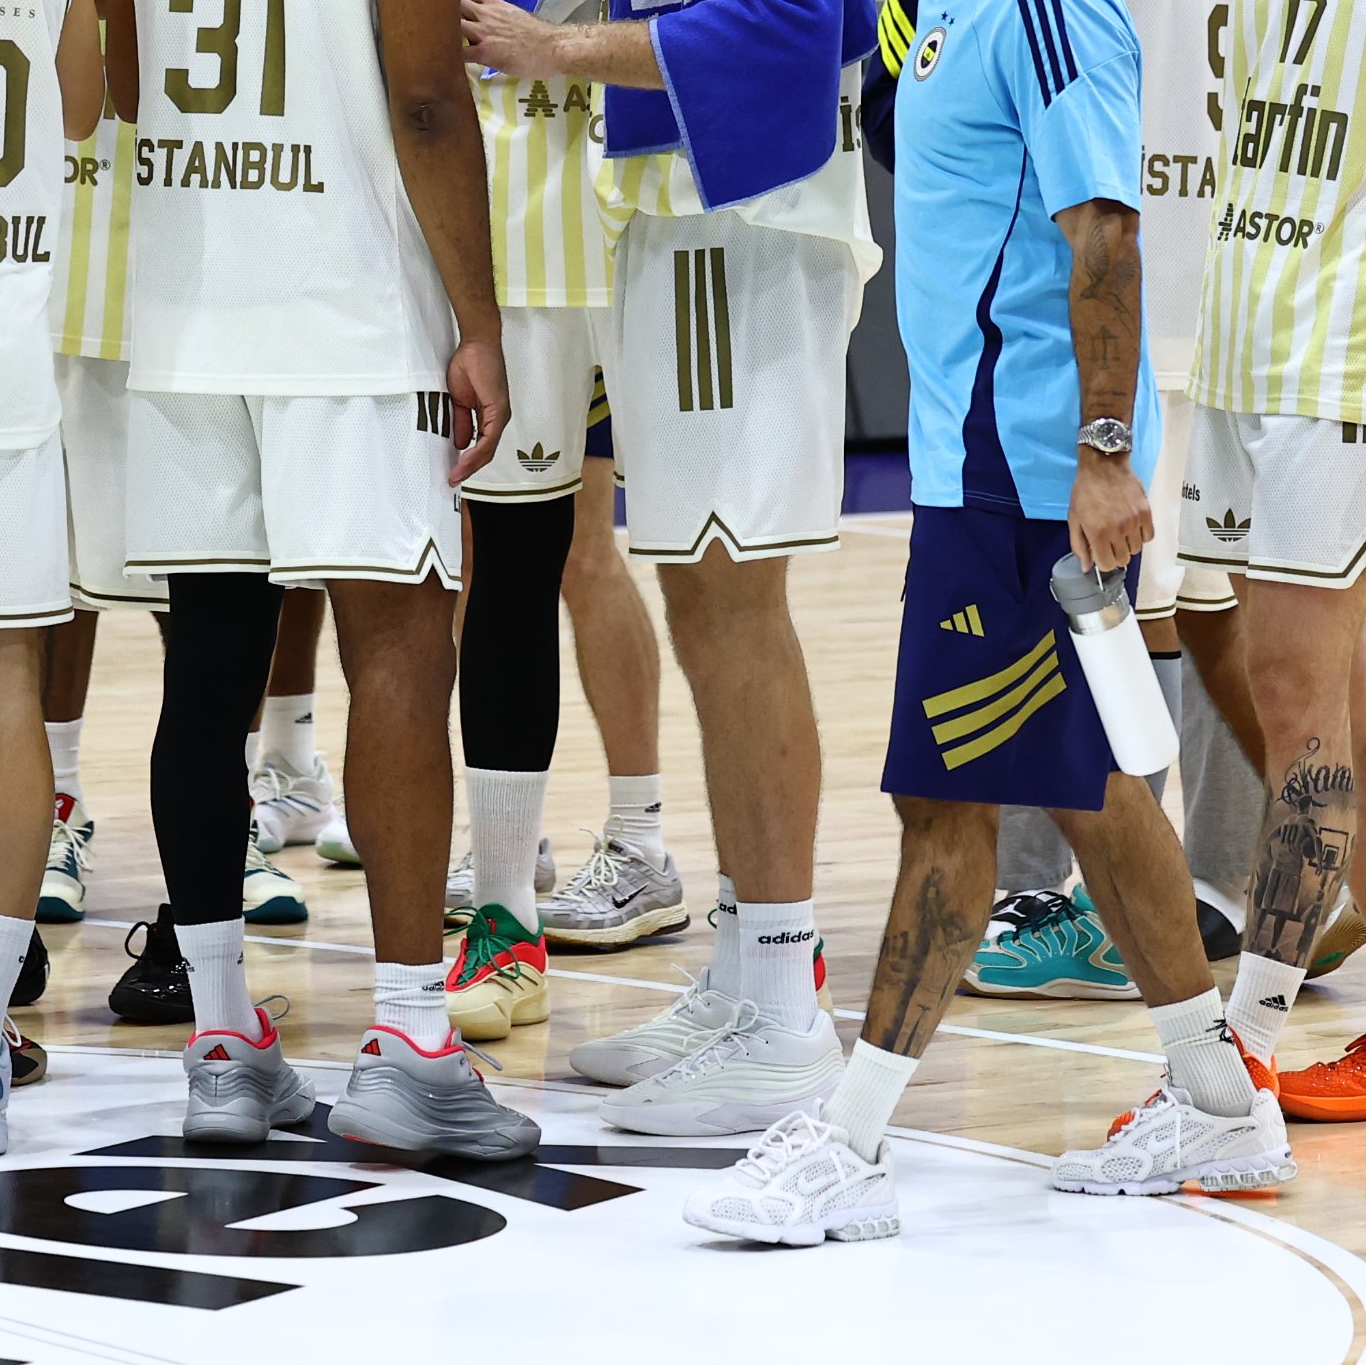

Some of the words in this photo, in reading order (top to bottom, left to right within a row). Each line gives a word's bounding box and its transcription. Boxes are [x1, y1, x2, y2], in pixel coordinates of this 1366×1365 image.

[1232, 76, 1349, 181] tarfin
[135, 129, 325, 194] STANBUL
[758, 929, 815, 945] adidas
[1258, 999, 1289, 1012] adidas
